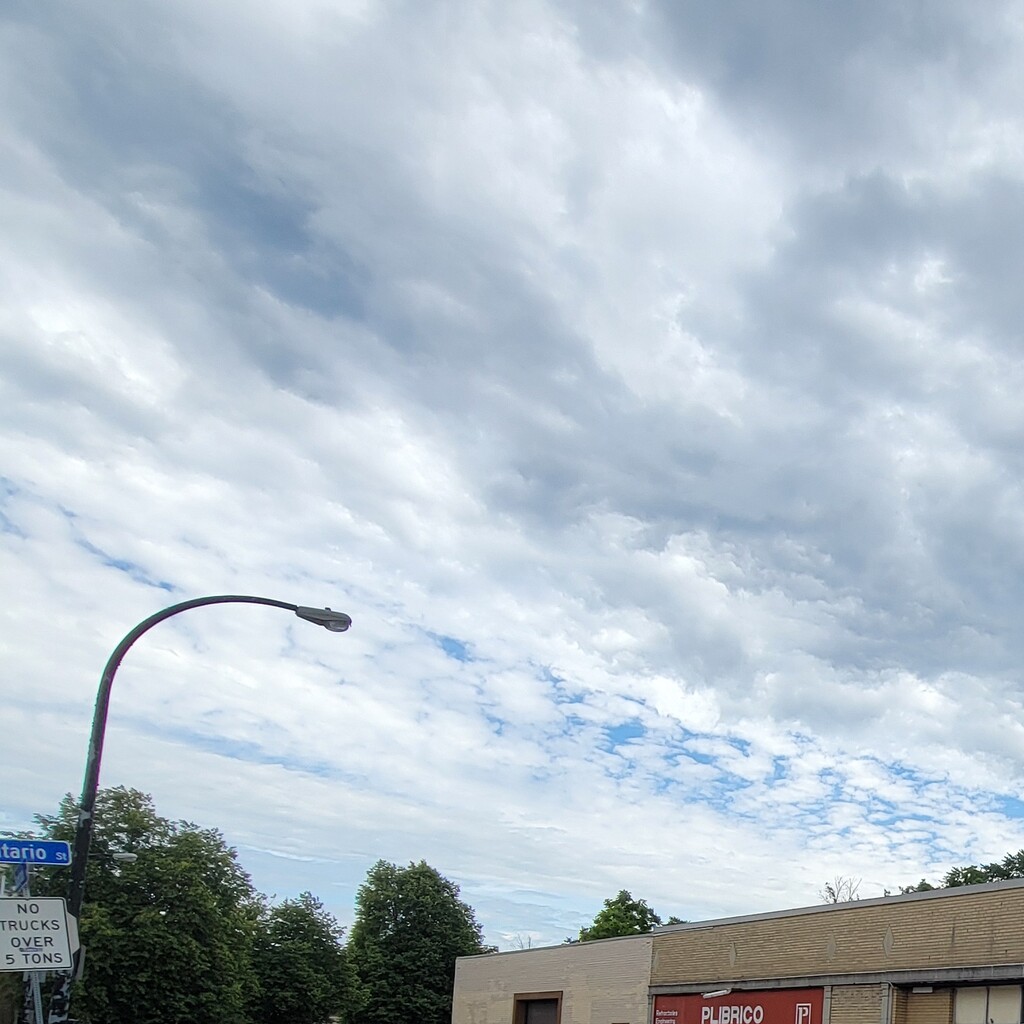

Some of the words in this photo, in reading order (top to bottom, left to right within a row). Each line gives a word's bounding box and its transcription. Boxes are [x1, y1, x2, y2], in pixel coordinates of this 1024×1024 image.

[0, 844, 47, 860] tario
[55, 852, 67, 861] St
[17, 904, 39, 914] NO
[0, 920, 60, 931] TRUCKS
[11, 937, 54, 948] OVER
[6, 954, 15, 965] 5
[22, 953, 63, 964] TONS
[701, 1005, 764, 1024] PLIBRICO
